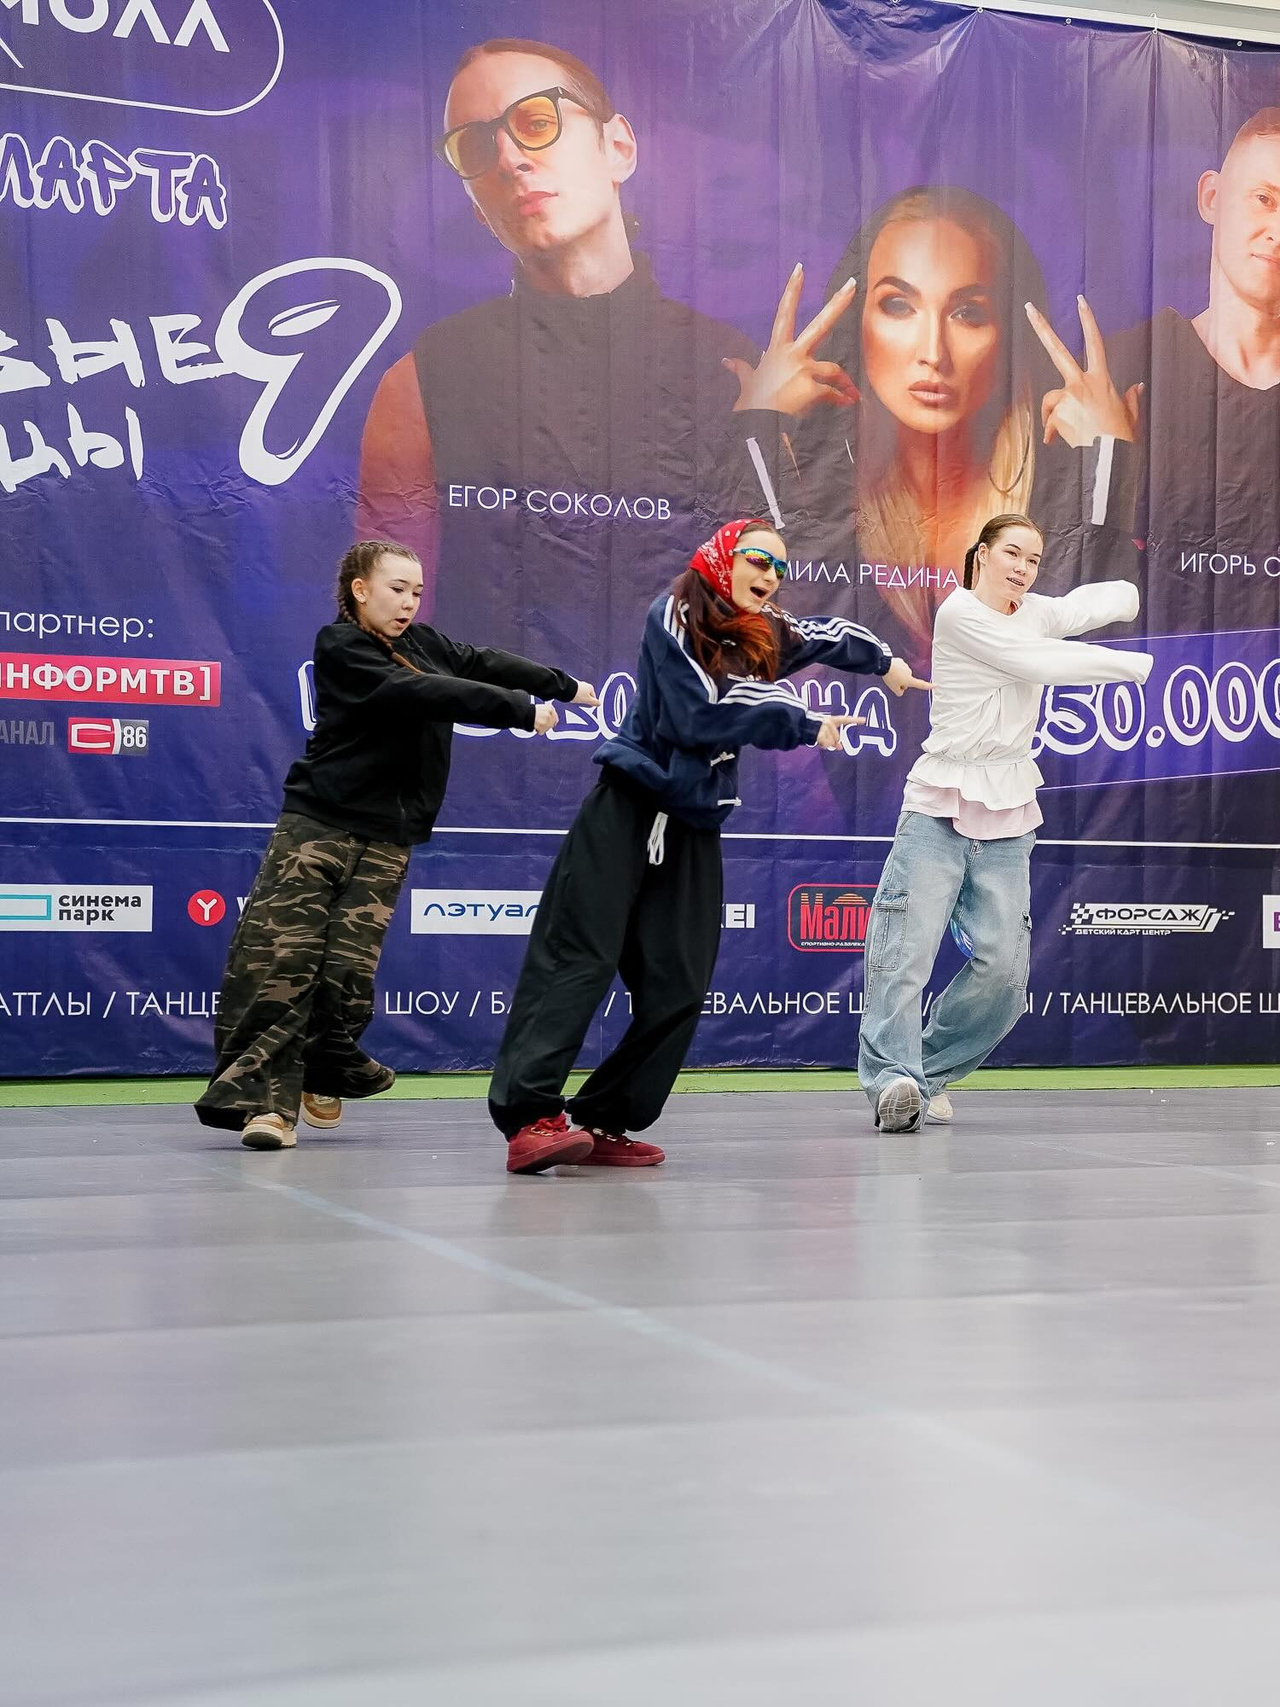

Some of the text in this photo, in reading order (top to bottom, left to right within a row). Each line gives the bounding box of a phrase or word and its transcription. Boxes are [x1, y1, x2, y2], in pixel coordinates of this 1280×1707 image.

[449, 485, 671, 520] ЕГОР СОКОЛОВ
[859, 563, 960, 589] РЕДИНА
[1181, 552, 1256, 576] ИГОРЬ
[0, 663, 211, 701] НФОРМТВ]
[58, 894, 142, 908] синема
[58, 907, 115, 925] парк
[1095, 907, 1201, 921] ФОРСАЖ
[385, 991, 460, 1015] ШОУ
[1060, 992, 1252, 1017] ТАНЦЕВАЛЬНОЕ
